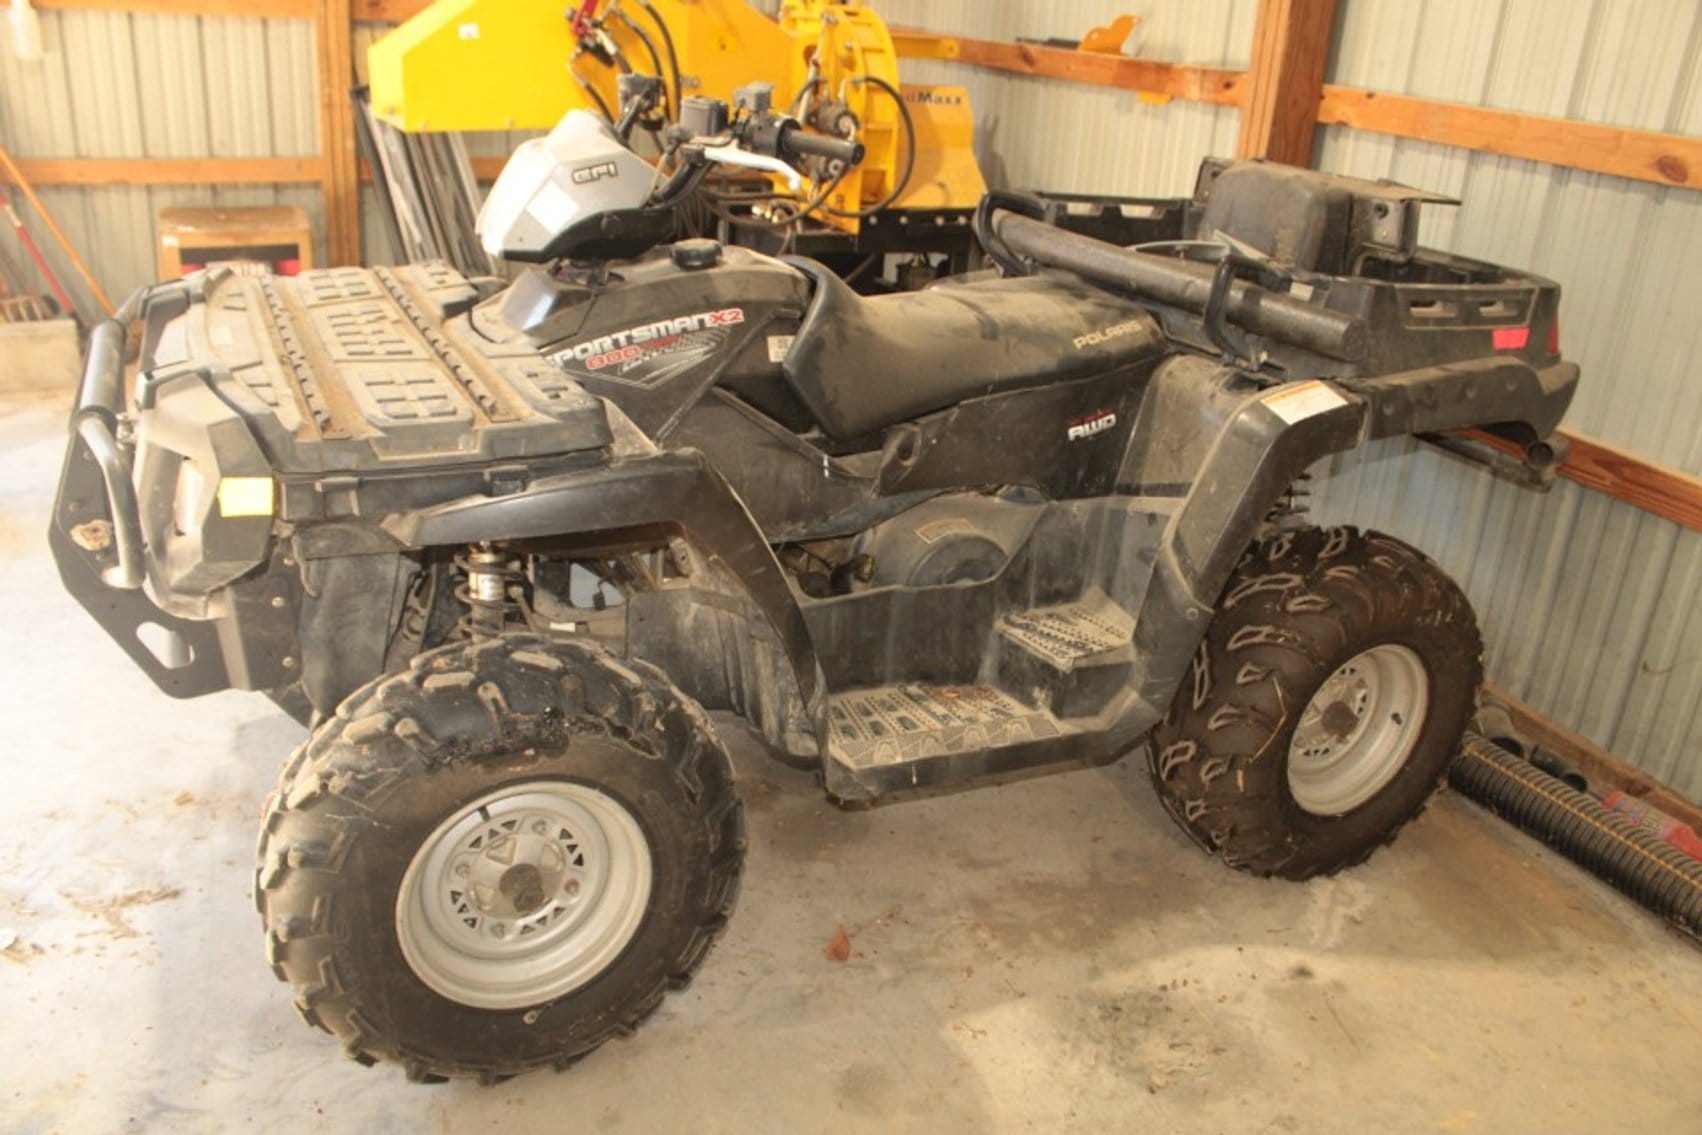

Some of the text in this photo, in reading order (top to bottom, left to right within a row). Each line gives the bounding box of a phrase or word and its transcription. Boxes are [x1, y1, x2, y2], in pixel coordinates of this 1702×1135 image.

[571, 161, 618, 185] EFI
[1072, 320, 1143, 350] POLARIS
[1068, 413, 1117, 441] AWD
